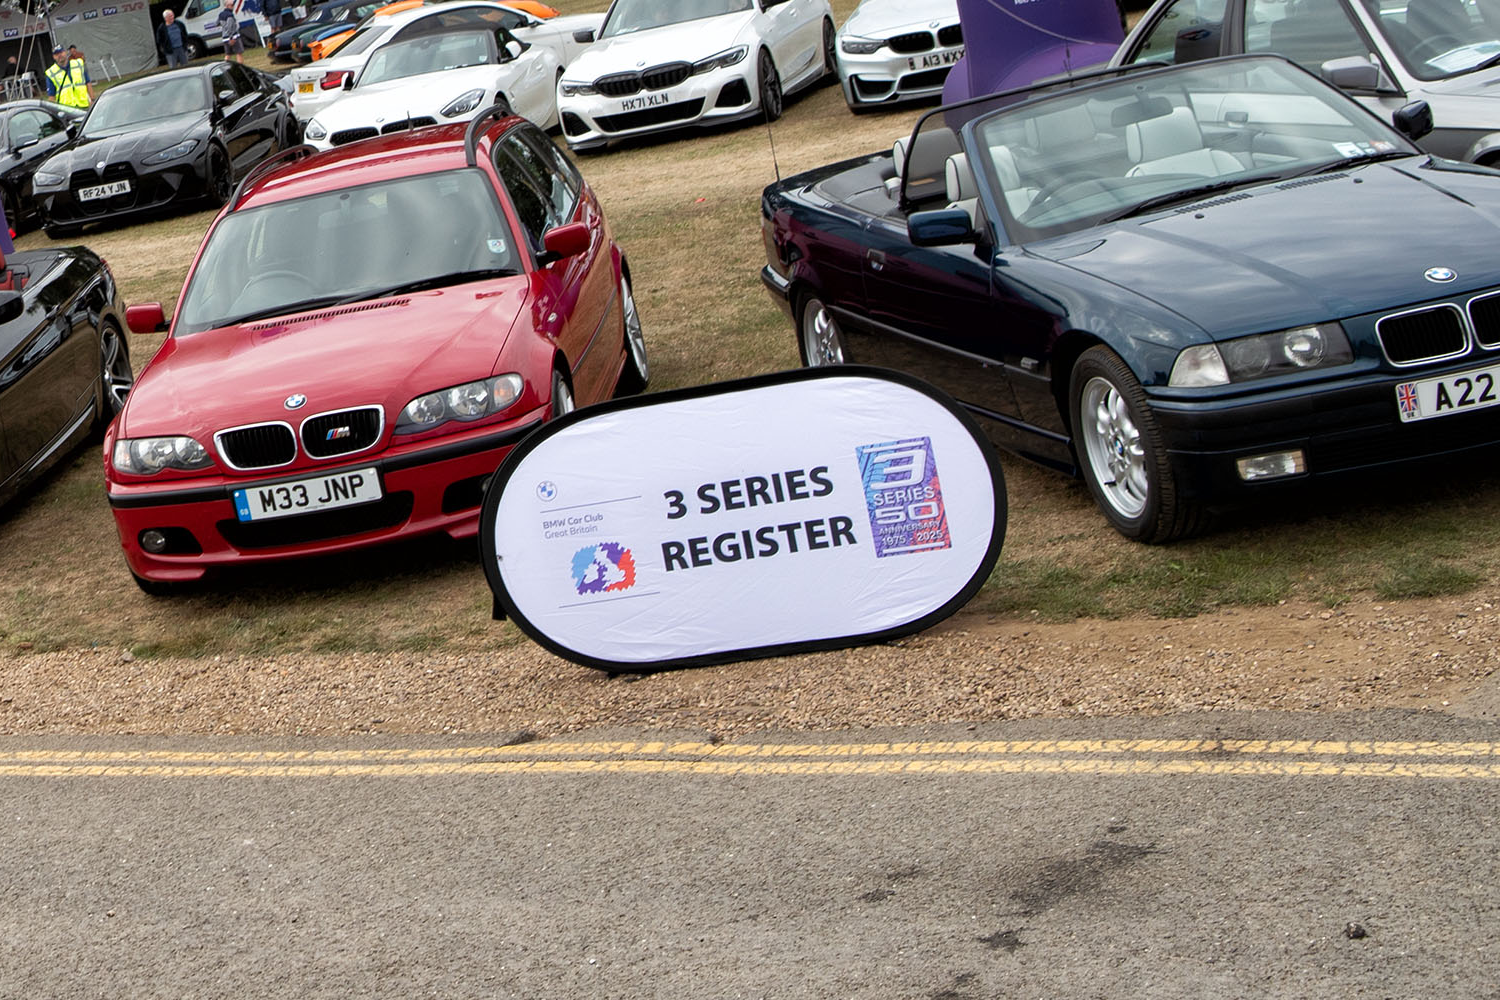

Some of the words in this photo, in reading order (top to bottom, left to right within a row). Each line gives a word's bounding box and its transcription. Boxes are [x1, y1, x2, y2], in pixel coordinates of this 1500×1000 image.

[622, 97, 646, 111] HX71
[648, 93, 669, 106] XLN
[83, 187, 107, 199] RF24
[108, 181, 127, 194] YJN
[1436, 373, 1497, 411] A22
[870, 449, 927, 491] 3
[259, 484, 310, 513] M33
[318, 473, 364, 503] JNP
[663, 490, 688, 519] 3
[697, 466, 834, 514] SERIES
[873, 486, 935, 506] SERIES
[543, 519, 566, 530] BMW
[567, 517, 582, 526] Car
[583, 513, 604, 523] Club
[875, 501, 940, 525] 50
[545, 530, 568, 539] Great
[569, 525, 598, 536] Britain
[879, 520, 941, 536] ANNIVERSARY
[882, 534, 906, 546] 1975
[916, 530, 943, 542] 2025
[661, 516, 858, 572] REGISTER
